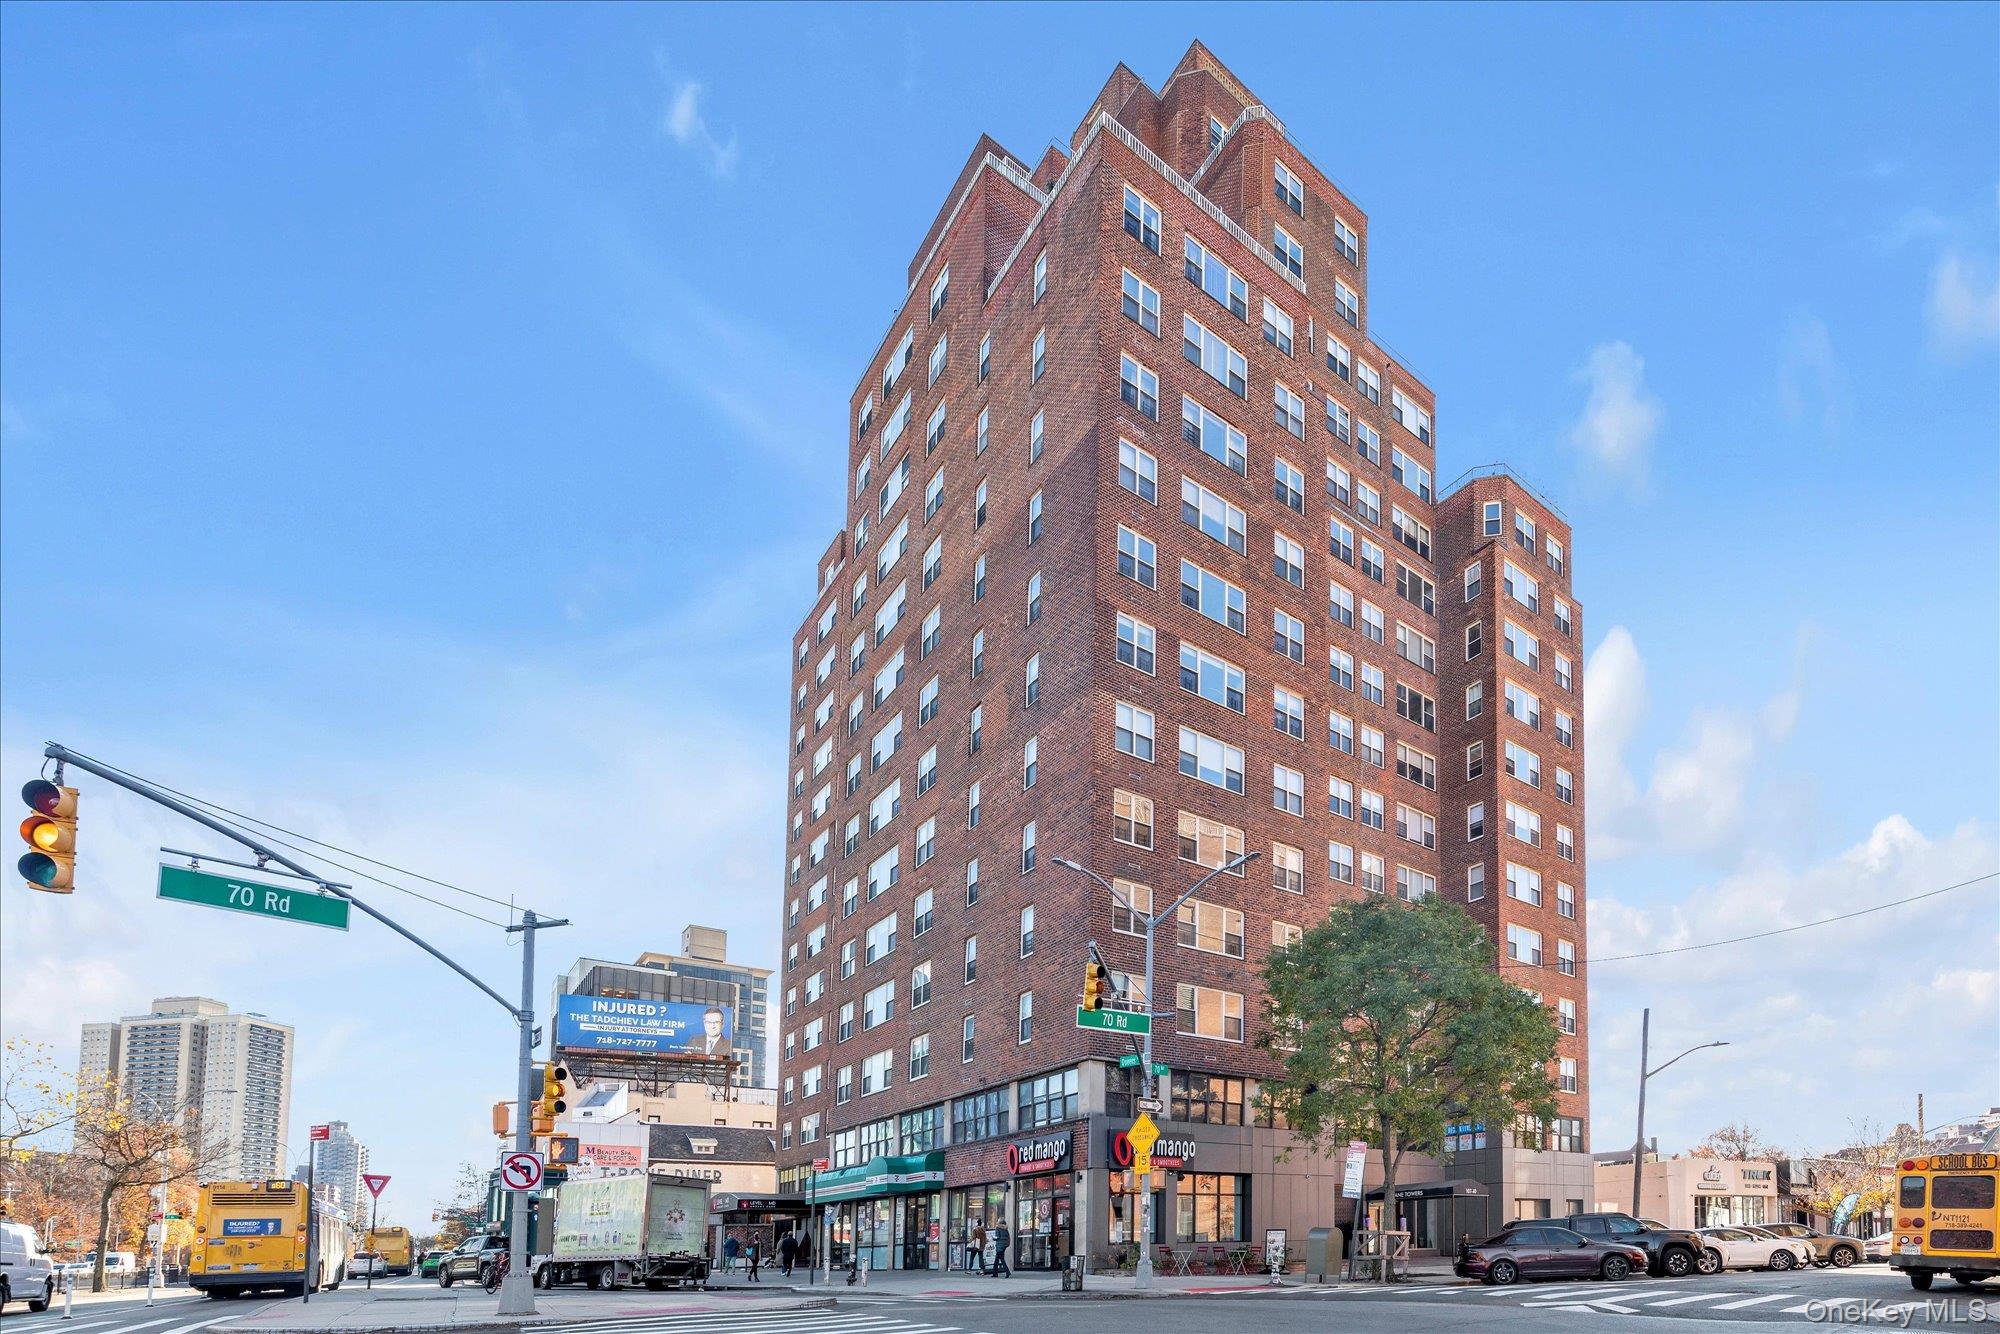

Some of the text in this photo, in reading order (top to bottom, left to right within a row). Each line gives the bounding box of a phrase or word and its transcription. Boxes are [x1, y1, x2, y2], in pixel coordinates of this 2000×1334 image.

[227, 883, 291, 914] 70 Rd
[592, 1000, 667, 1017] INJURED ?
[570, 1013, 685, 1030] THE TADCHIEV LAW FIRM
[1102, 1013, 1127, 1028] 70 Rd
[621, 1026, 658, 1035] ATTORNEYS
[596, 1035, 657, 1048] 718-727-7777
[585, 1146, 595, 1155] M
[1018, 1139, 1066, 1163] red mango
[1156, 1139, 1196, 1162] mango
[1138, 1155, 1147, 1166] 15
[1938, 1155, 1988, 1169] SCHOOL BUS
[675, 1168, 722, 1184] DINER
[1942, 1214, 1970, 1223] NT1121
